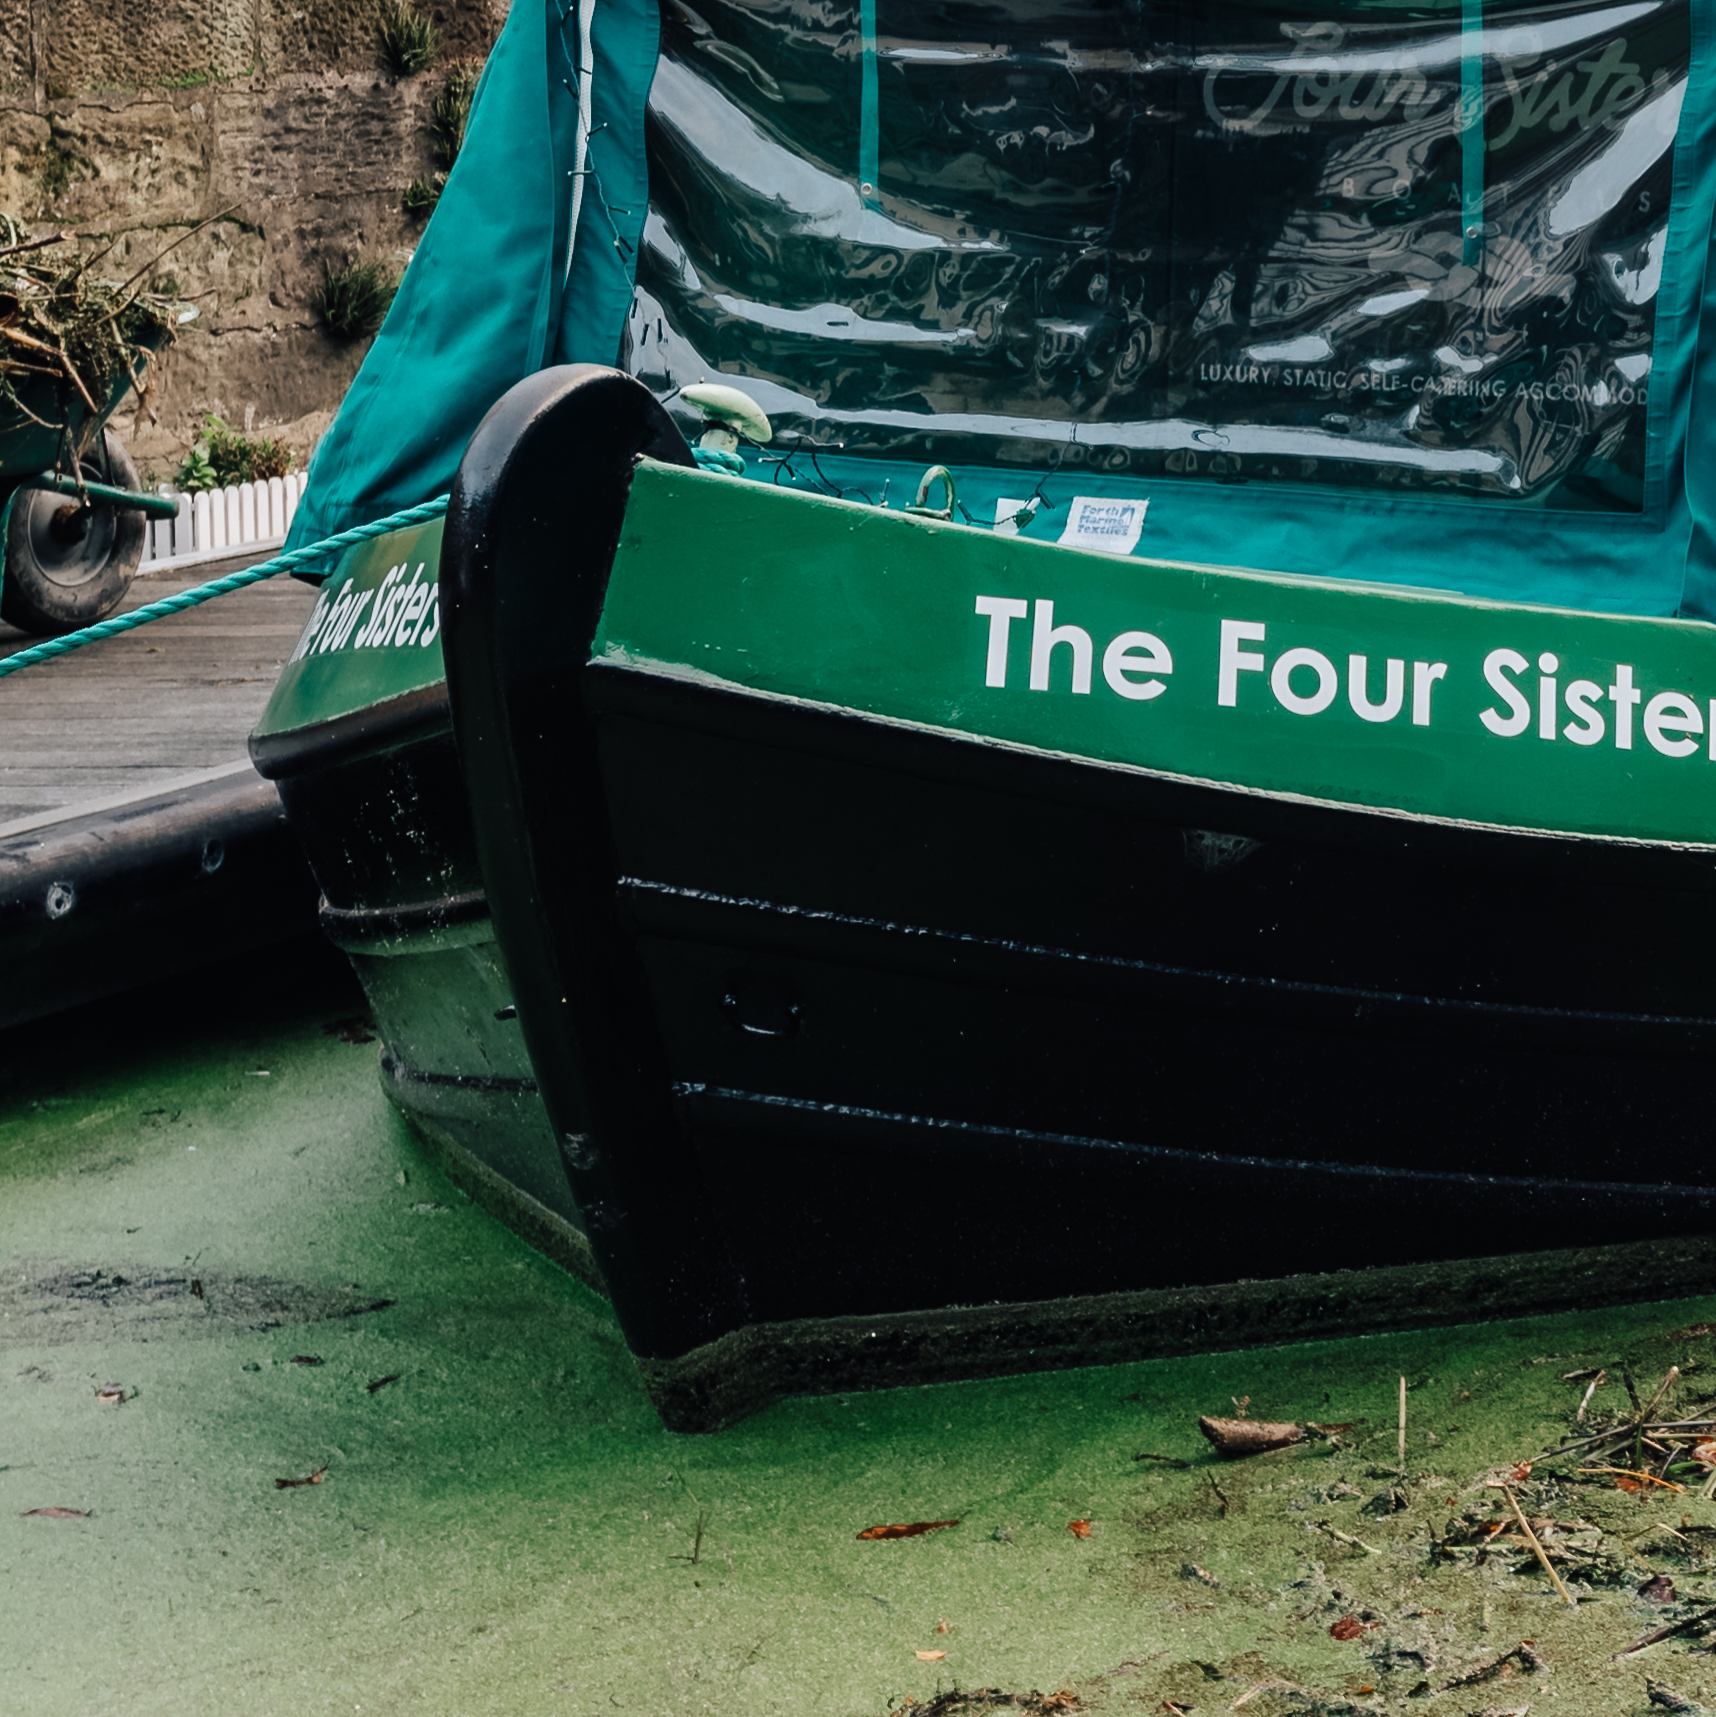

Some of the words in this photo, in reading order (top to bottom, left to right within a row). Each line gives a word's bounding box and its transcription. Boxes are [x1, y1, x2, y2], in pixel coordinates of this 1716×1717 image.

[1081, 504, 1120, 517] Forth
[1079, 514, 1124, 526] Marine
[1077, 524, 1129, 537] Textiles
[309, 578, 374, 655] Four
[974, 594, 1174, 701] The
[1217, 618, 1448, 727] Four
